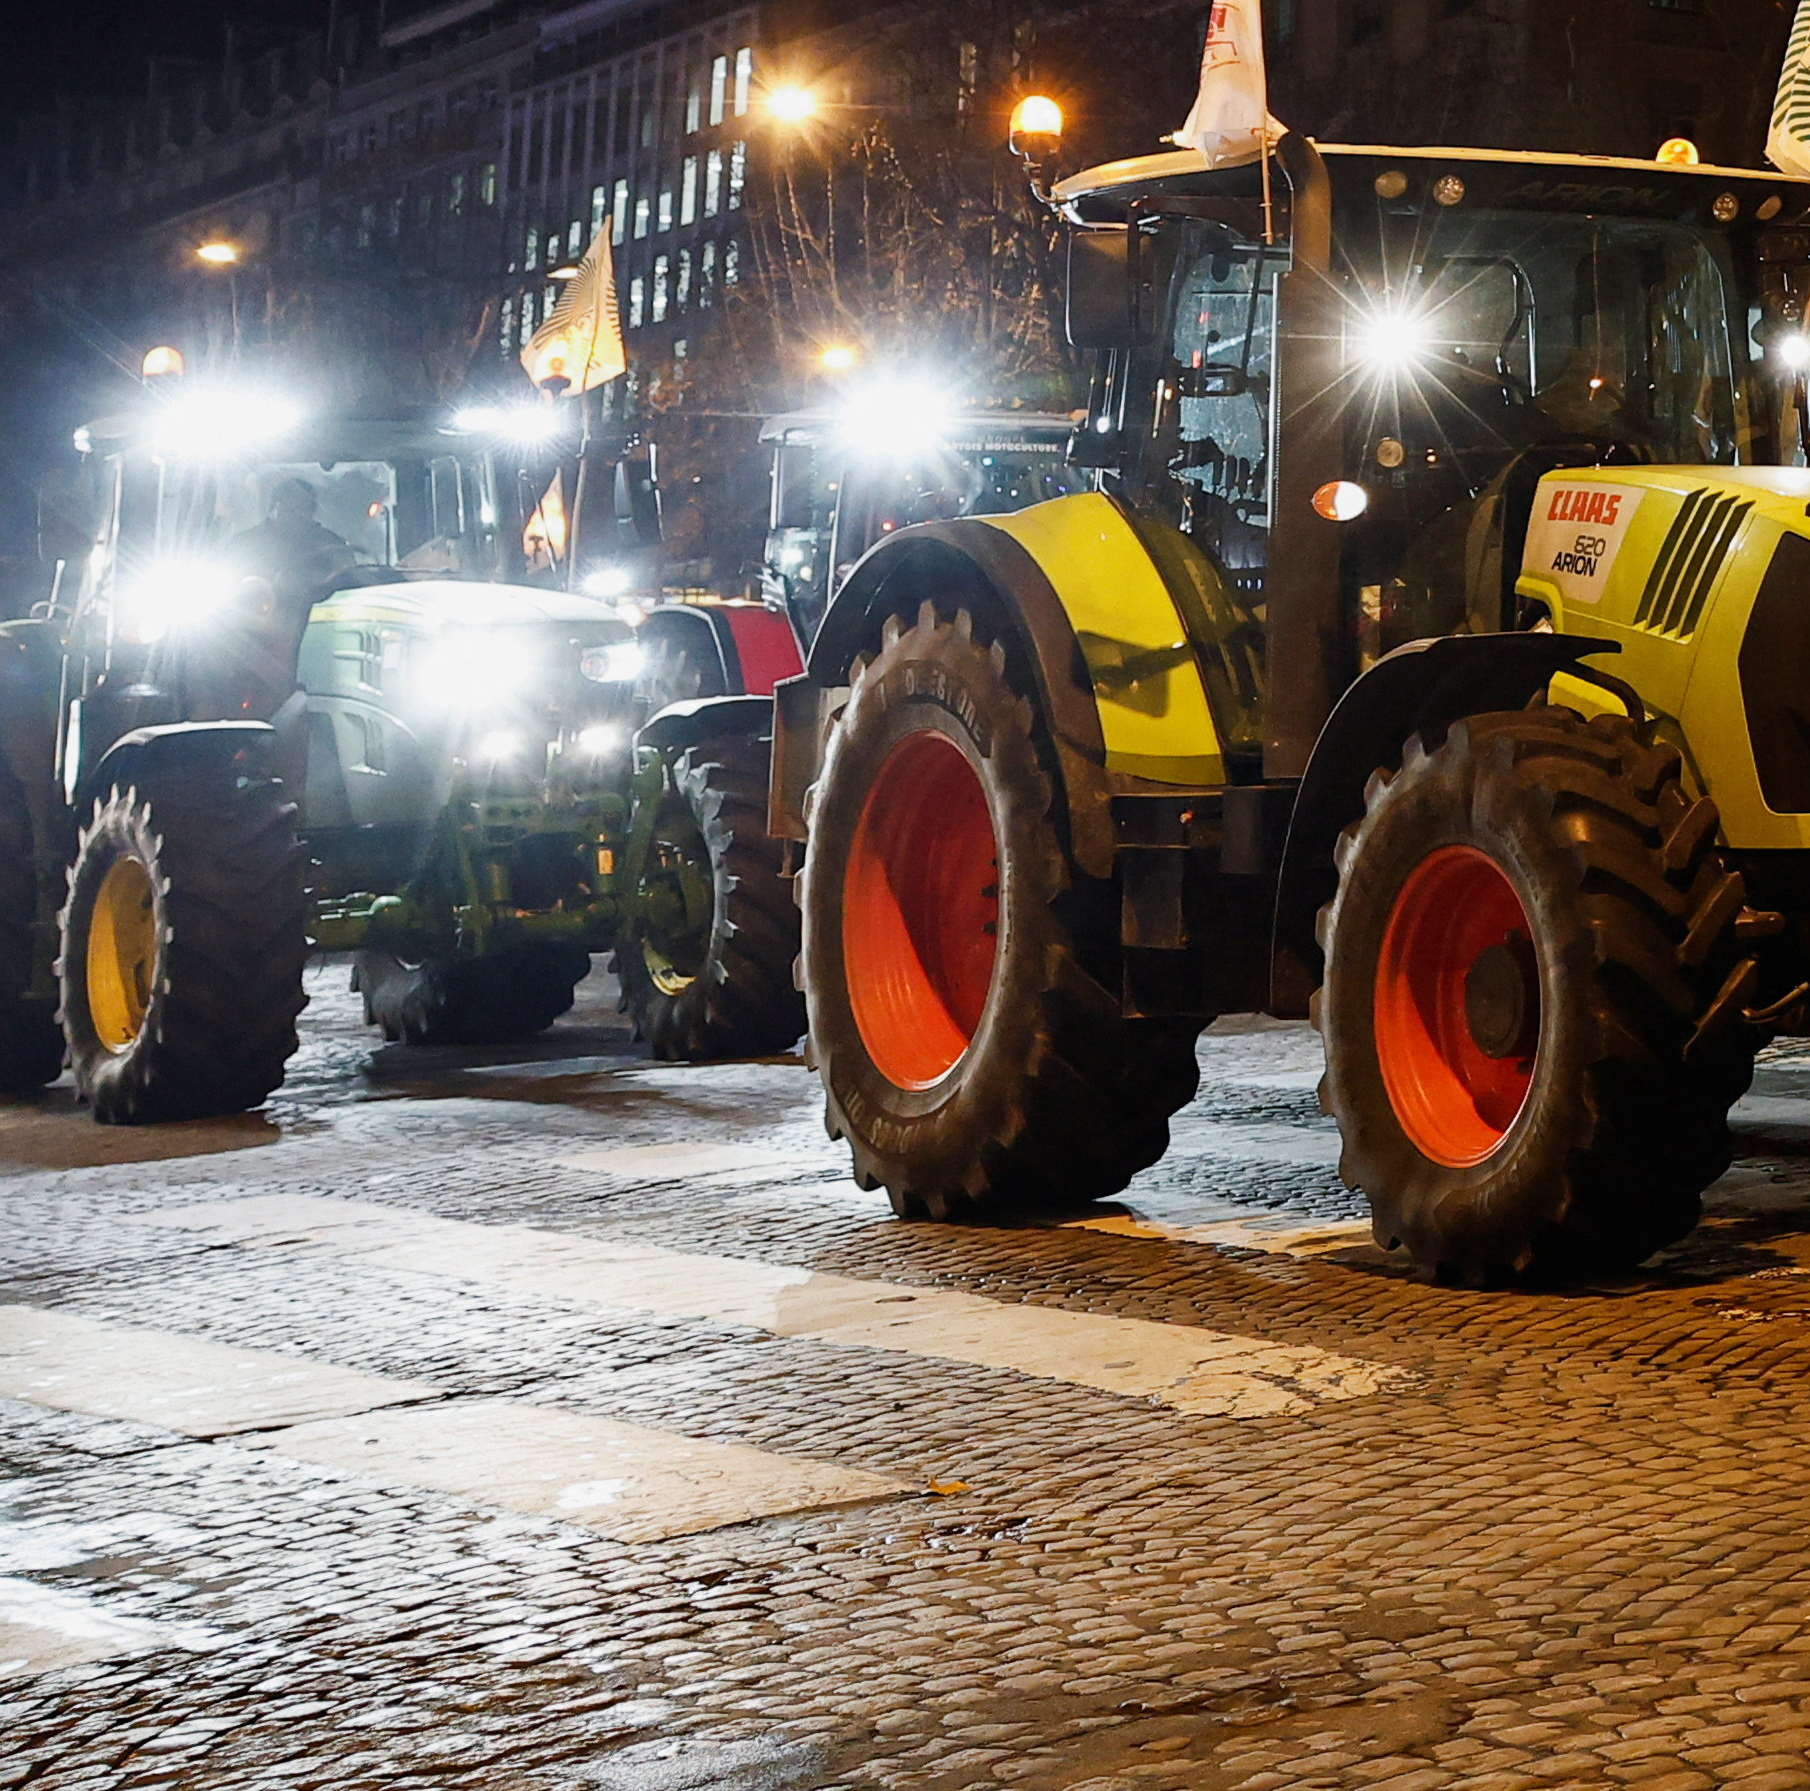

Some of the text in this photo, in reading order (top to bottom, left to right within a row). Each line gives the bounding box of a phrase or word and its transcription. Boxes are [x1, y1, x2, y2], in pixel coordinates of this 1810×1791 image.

[1547, 490, 1623, 526] CLAAS
[1574, 534, 1607, 558] 620
[1551, 551, 1598, 578] ARION
